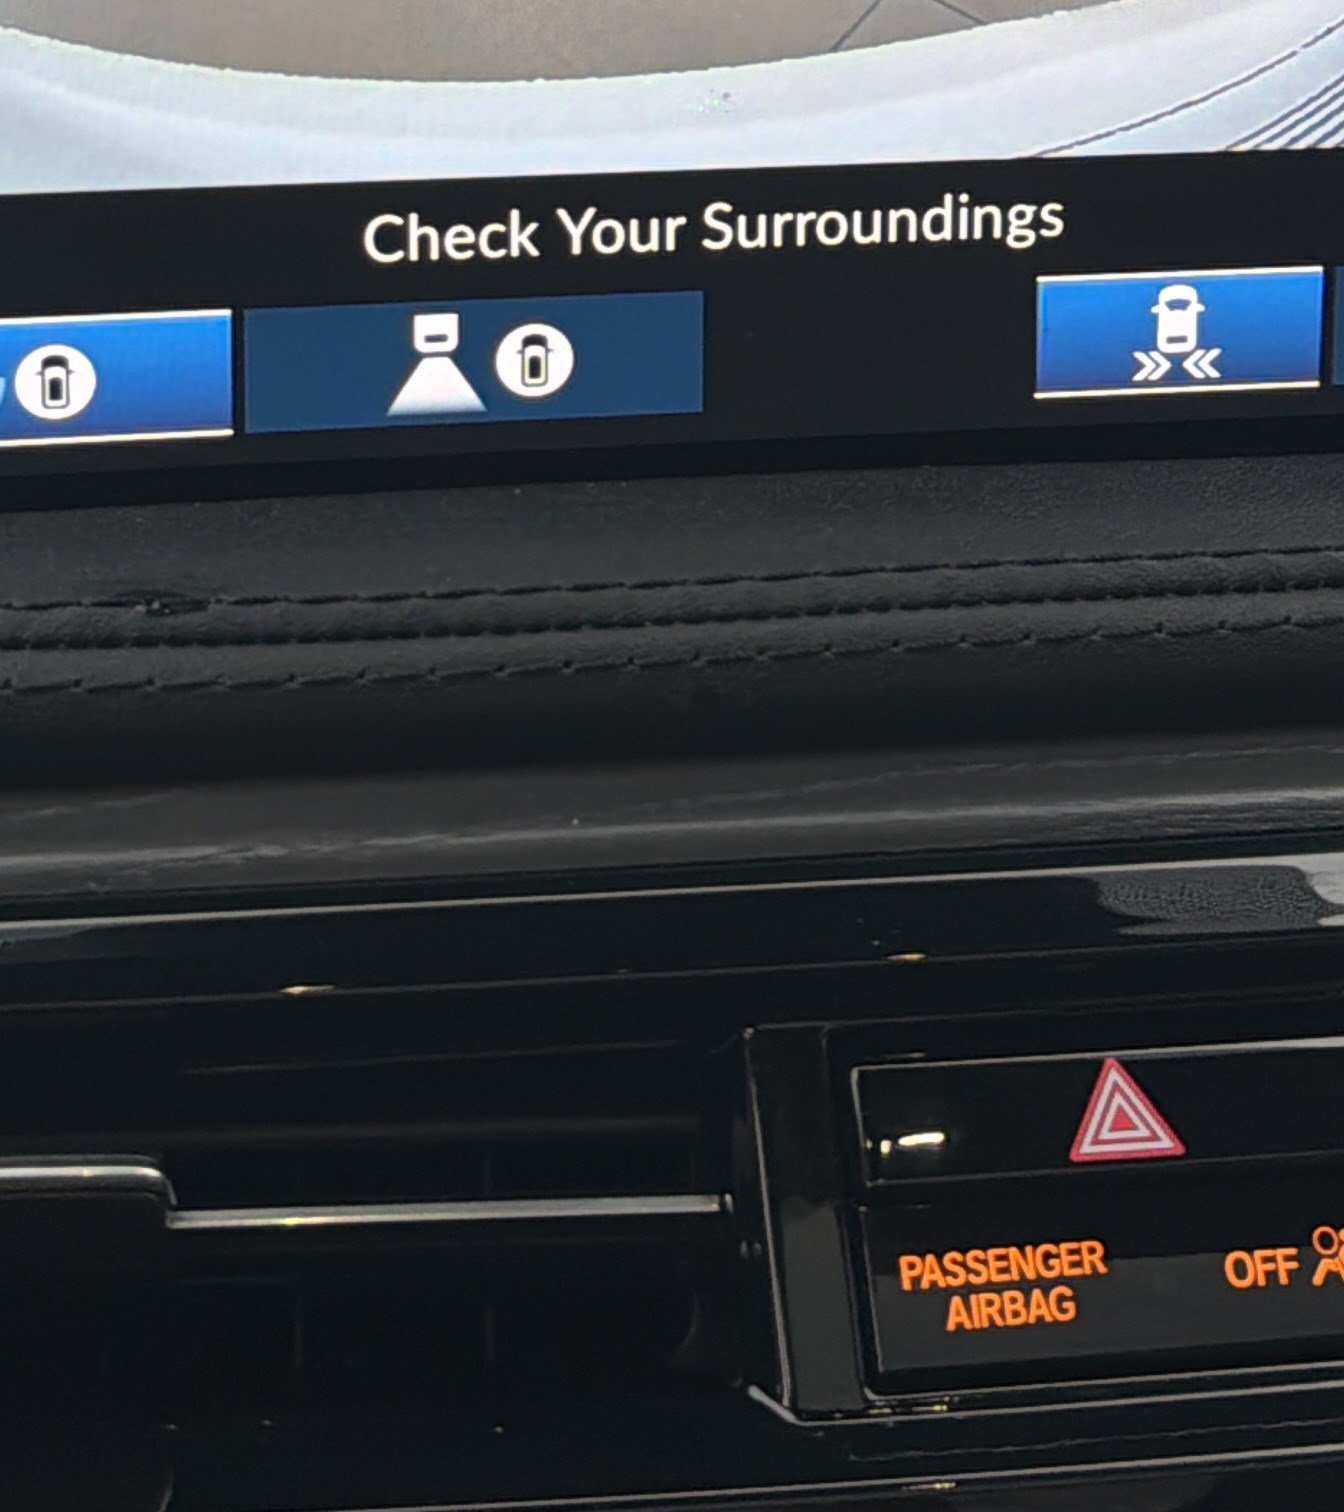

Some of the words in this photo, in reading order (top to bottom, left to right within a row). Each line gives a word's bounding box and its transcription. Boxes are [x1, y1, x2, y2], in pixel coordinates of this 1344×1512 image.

[362, 210, 540, 263] Check
[556, 205, 686, 255] Your
[702, 194, 1065, 249] Surroundings
[899, 1241, 1107, 1291] PASSENGER
[1224, 1247, 1299, 1289] OFF
[945, 1286, 1077, 1333] AIRBAG
